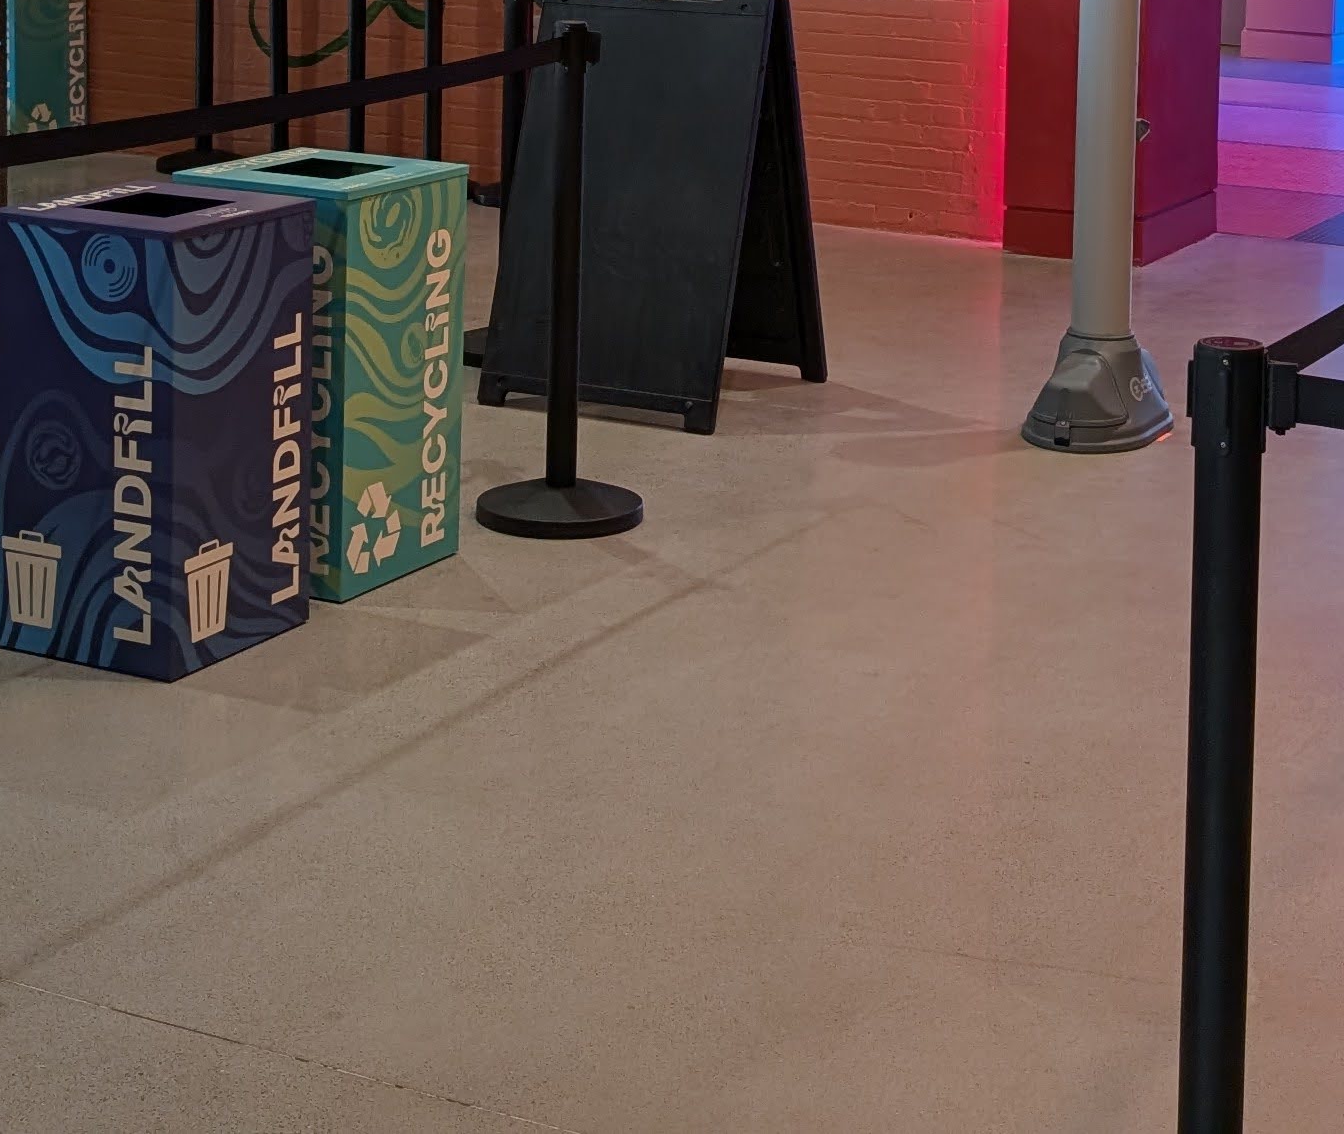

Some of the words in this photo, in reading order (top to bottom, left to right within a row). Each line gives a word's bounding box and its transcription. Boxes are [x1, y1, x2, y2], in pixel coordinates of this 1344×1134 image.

[18, 185, 156, 212] LANDFILL
[113, 346, 154, 646] LANDFILL
[271, 312, 303, 605] LANDFILL
[420, 228, 453, 548] RECYCLING
